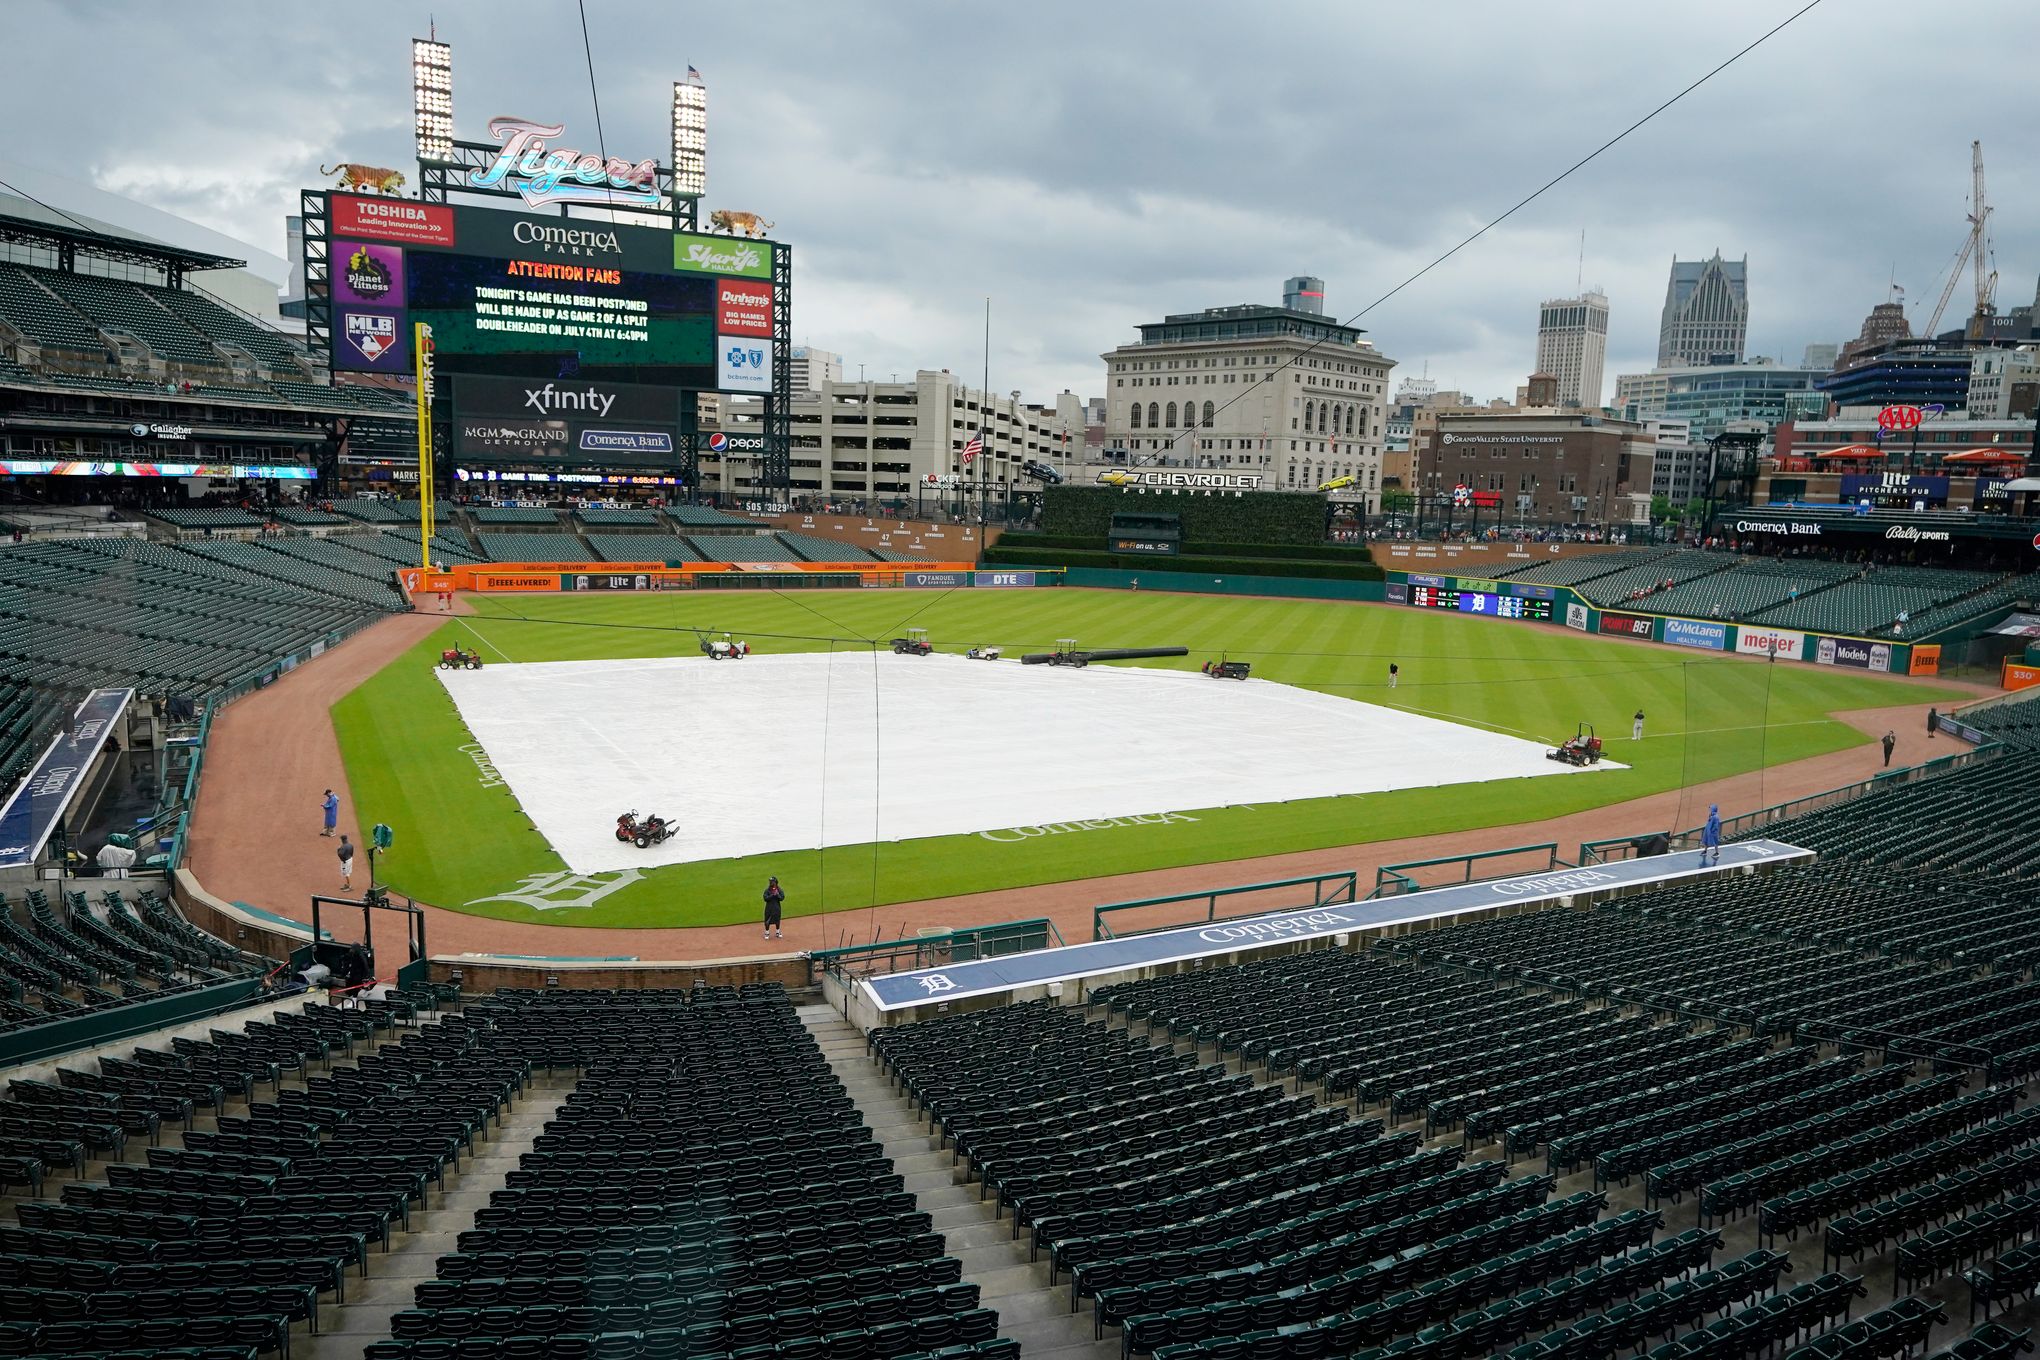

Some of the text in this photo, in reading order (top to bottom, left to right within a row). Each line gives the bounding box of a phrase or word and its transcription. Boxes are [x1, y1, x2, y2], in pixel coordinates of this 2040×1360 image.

[468, 117, 657, 196] Tigers
[357, 202, 427, 221] TOSHIBA
[357, 217, 428, 231] Leading Innovation
[544, 244, 594, 256] PARK
[507, 260, 622, 285] ATTENTION FANS
[711, 264, 735, 272] HALAL
[348, 273, 382, 283] planet
[353, 282, 389, 291] fitness
[475, 286, 648, 312] TONIGHT'S GAME HAS BEEN POSTPONED
[722, 291, 770, 307] Dunham's
[475, 302, 648, 327] WILL BE MADE UP AS GAME 2 OF A SPLIT
[740, 312, 766, 320] NAMES
[348, 316, 392, 332] MLB
[724, 318, 767, 328] LOW PRICES
[1992, 318, 2014, 327] 1001
[349, 329, 392, 337] NETWORK
[476, 318, 547, 334] DOUBLEHEADER
[549, 324, 561, 335] ON
[562, 325, 584, 338] JULY
[585, 326, 602, 339] 4TH
[603, 328, 615, 339] AT
[727, 374, 764, 382] bcbsm.com
[524, 384, 616, 417] xfinity
[1880, 406, 1921, 429] AAA
[150, 423, 193, 435] Gallagher
[464, 426, 566, 441] MGM GRAND
[484, 439, 548, 447] DETROIT
[638, 436, 665, 447] Bank
[729, 438, 764, 450] pepsi
[1520, 435, 1564, 443] UNIVERSITY
[472, 472, 483, 480] VS
[501, 473, 525, 481] GAME
[528, 473, 550, 482] TIME:
[557, 474, 602, 484] POSTPONED
[663, 477, 675, 485] PM
[922, 474, 960, 483] ROCKET
[1145, 472, 1262, 489] CHEVROLET
[1881, 471, 1911, 487] Lite
[1123, 487, 1242, 498] FOUNTAIN
[1859, 487, 1907, 495] PITCHER'S
[491, 500, 548, 508] CHEVROLET
[578, 502, 632, 510] CHEVROLET
[746, 502, 761, 511] 505
[767, 503, 787, 513] 3029
[867, 518, 873, 526] 5
[1791, 522, 1821, 535] Bank
[1885, 525, 1949, 543] Bally SPORTS
[1118, 541, 1136, 550] Wi-Fi
[1515, 544, 1523, 552] 11
[609, 577, 629, 588] Lite
[994, 574, 1017, 585] DTE
[1571, 609, 1583, 619] SVS
[1568, 618, 1585, 628] VISION
[1682, 623, 1723, 638] McLaren
[1677, 637, 1713, 647] HEALTH CARE
[1837, 647, 1868, 661] Modelo
[1539, 878, 1606, 894] PARK
[1255, 920, 1340, 941] PARK
